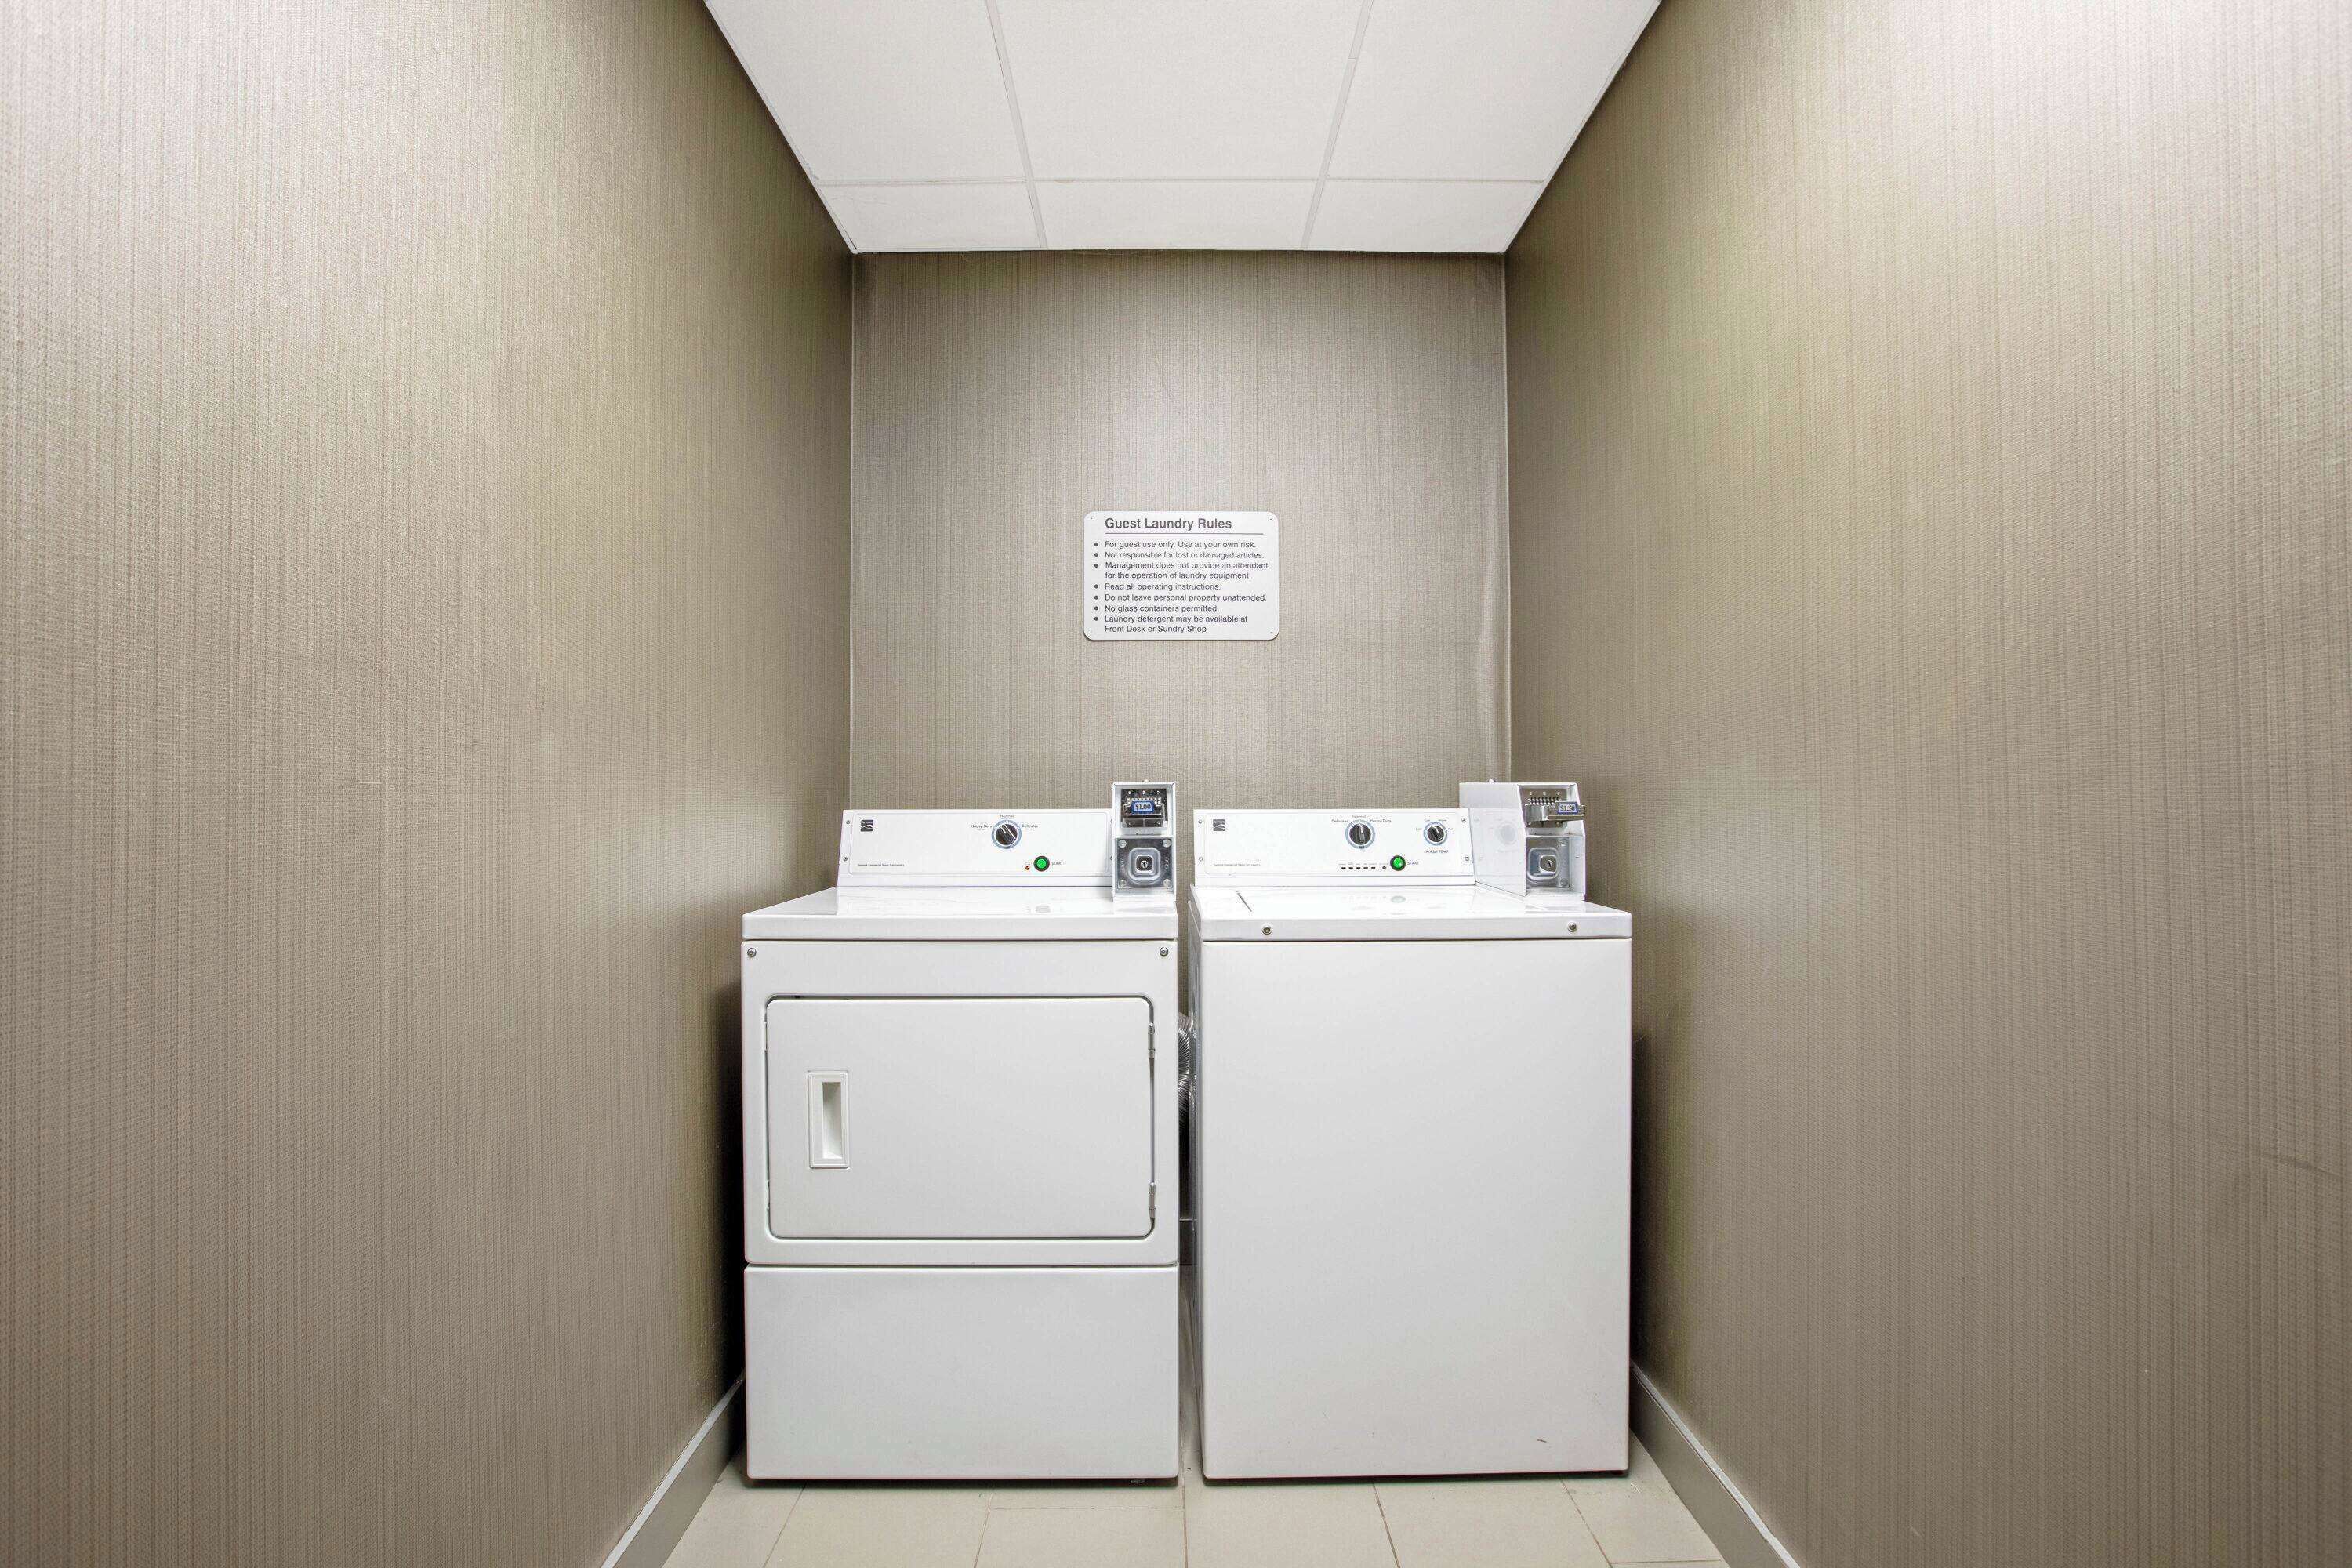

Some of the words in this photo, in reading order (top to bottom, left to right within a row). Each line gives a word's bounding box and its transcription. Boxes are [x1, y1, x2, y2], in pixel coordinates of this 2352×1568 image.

[1105, 518, 1141, 529] Guest
[1145, 518, 1194, 531] Laundry
[1198, 518, 1232, 529] Rules
[1137, 615, 1174, 624] detergent
